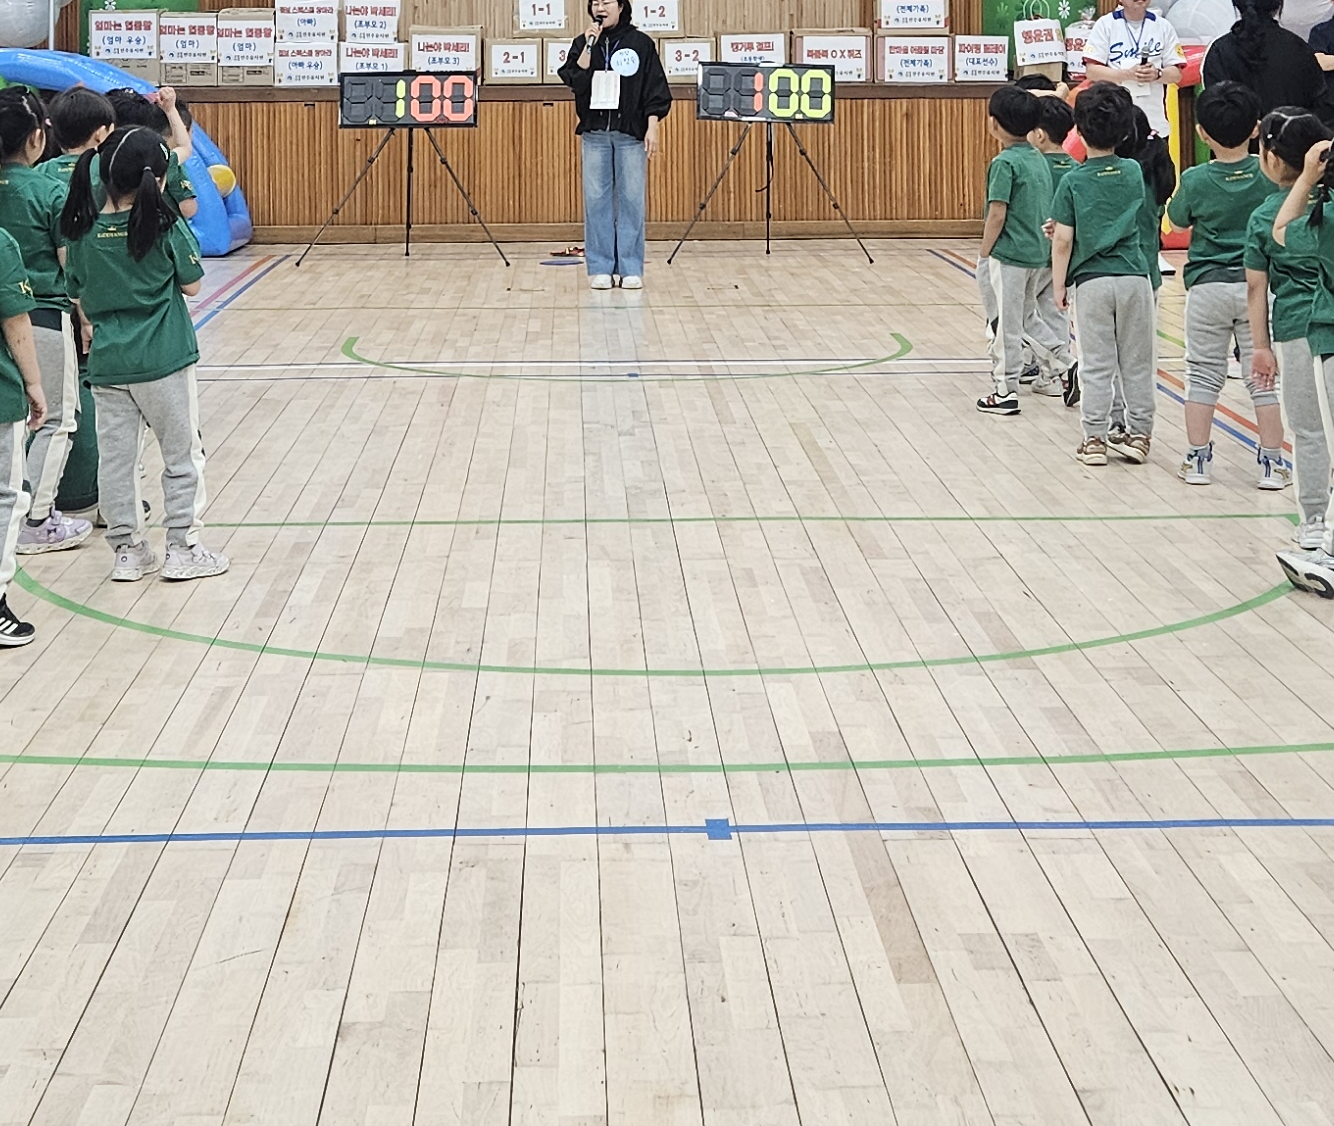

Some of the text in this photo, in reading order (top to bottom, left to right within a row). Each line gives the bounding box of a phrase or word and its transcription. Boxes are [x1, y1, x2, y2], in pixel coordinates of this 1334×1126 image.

[531, 2, 551, 16] 1-1
[643, 5, 666, 18] 1-2
[502, 51, 525, 64] 2-1
[675, 49, 700, 62] 3-2
[395, 75, 473, 122] 100
[753, 68, 831, 118] 100
